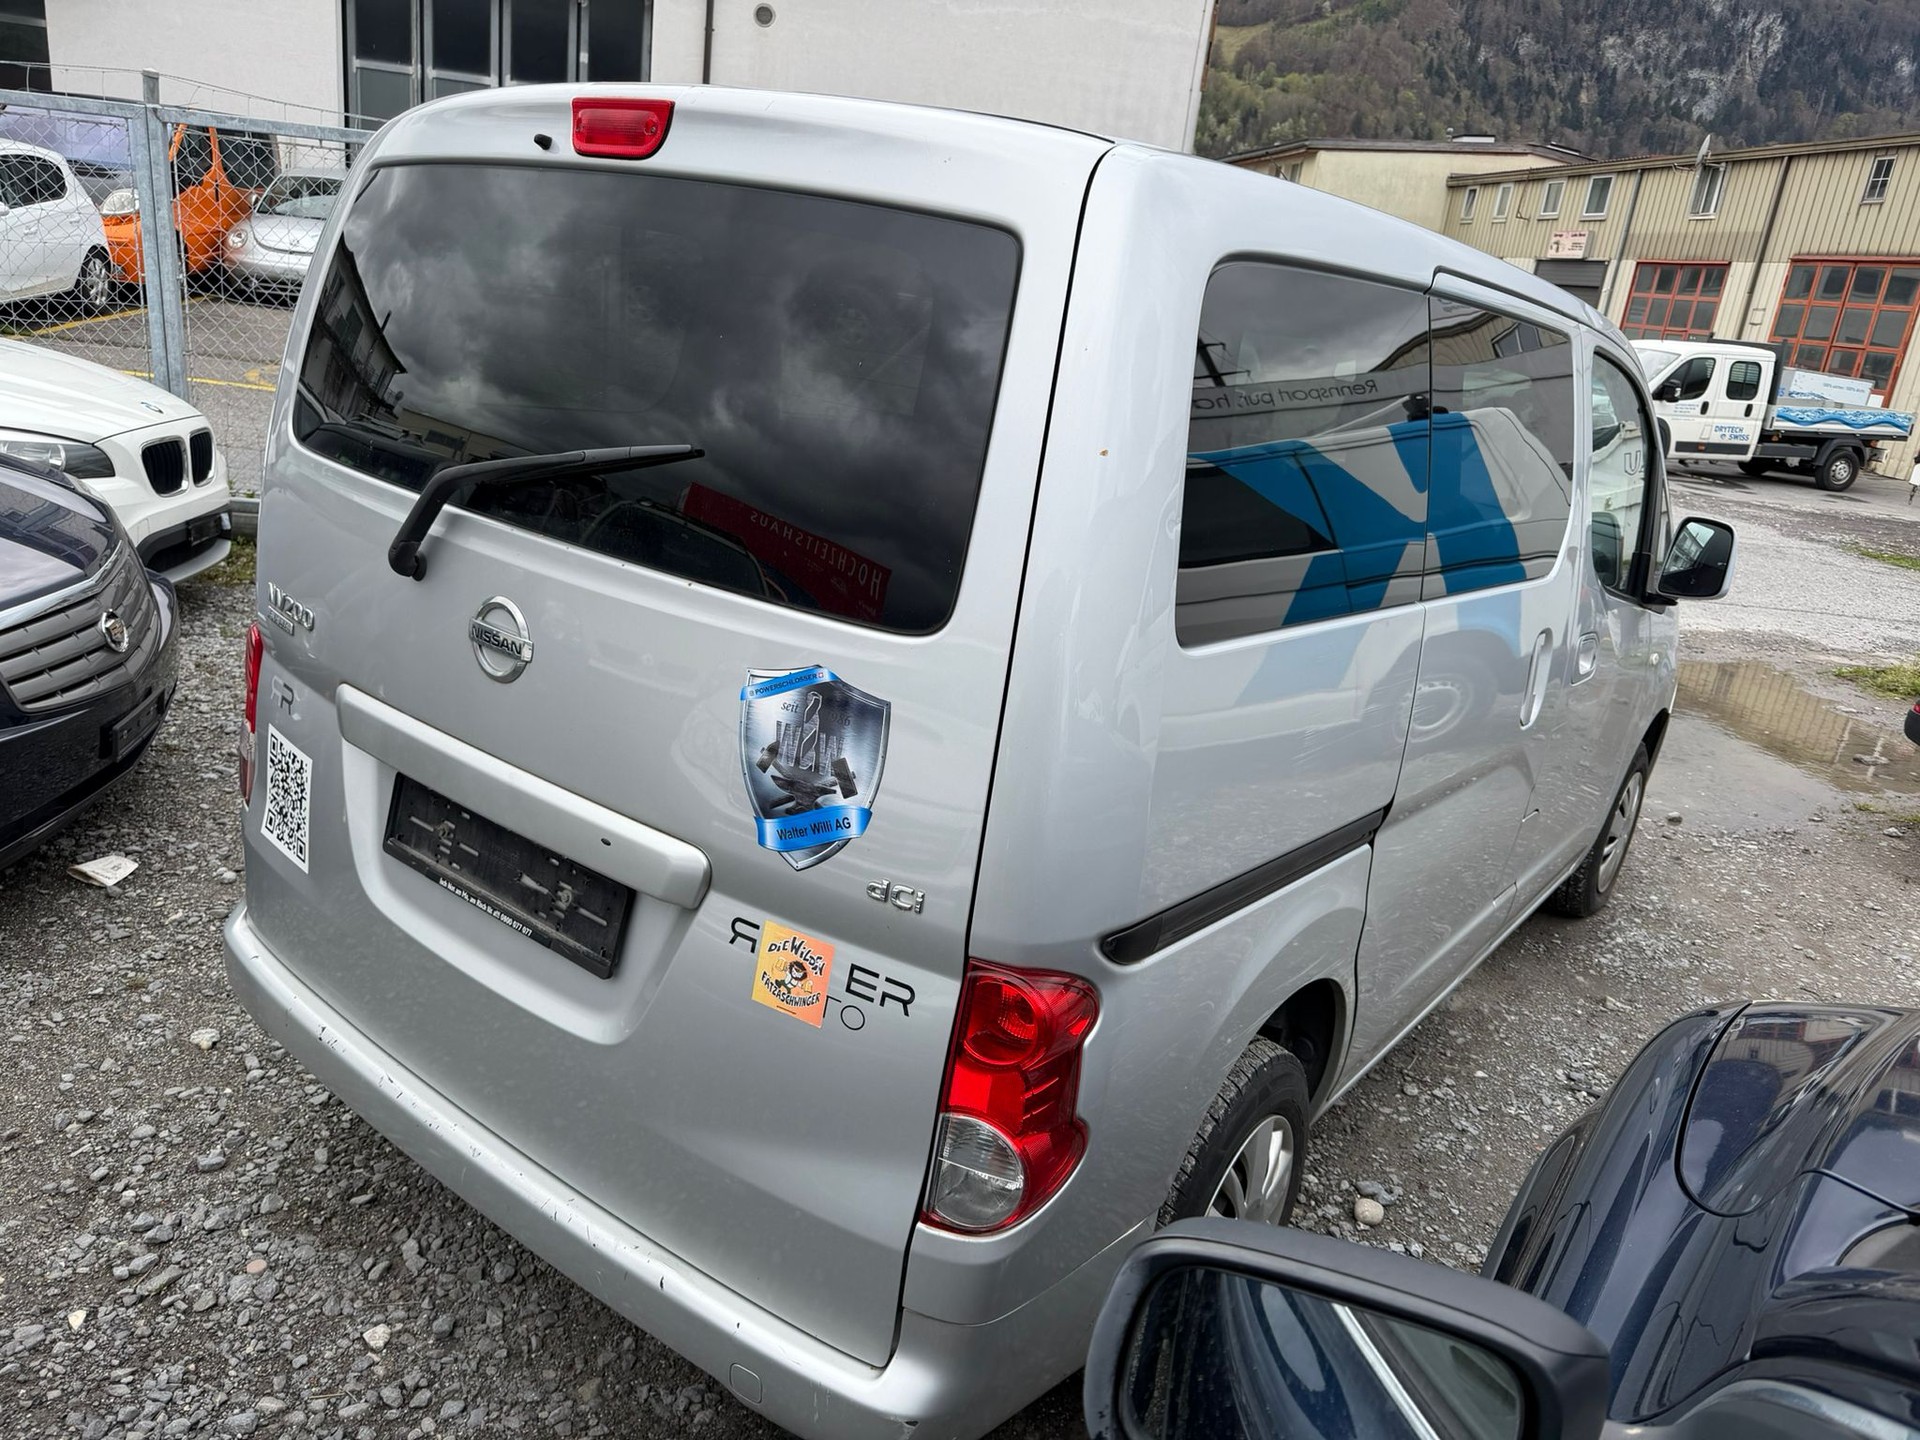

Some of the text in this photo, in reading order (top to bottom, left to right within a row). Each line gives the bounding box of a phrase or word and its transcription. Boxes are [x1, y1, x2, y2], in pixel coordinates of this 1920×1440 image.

[1713, 425, 1744, 434] DRYTECH
[1728, 433, 1750, 441] SWISS
[471, 624, 522, 655] NISSAN
[754, 673, 818, 696] POWERSCHLOSSER
[780, 701, 800, 714] seit
[776, 816, 852, 841] Walter Willi AG
[501, 914, 512, 925] 0800
[513, 921, 522, 930] 077
[522, 926, 532, 936] 077
